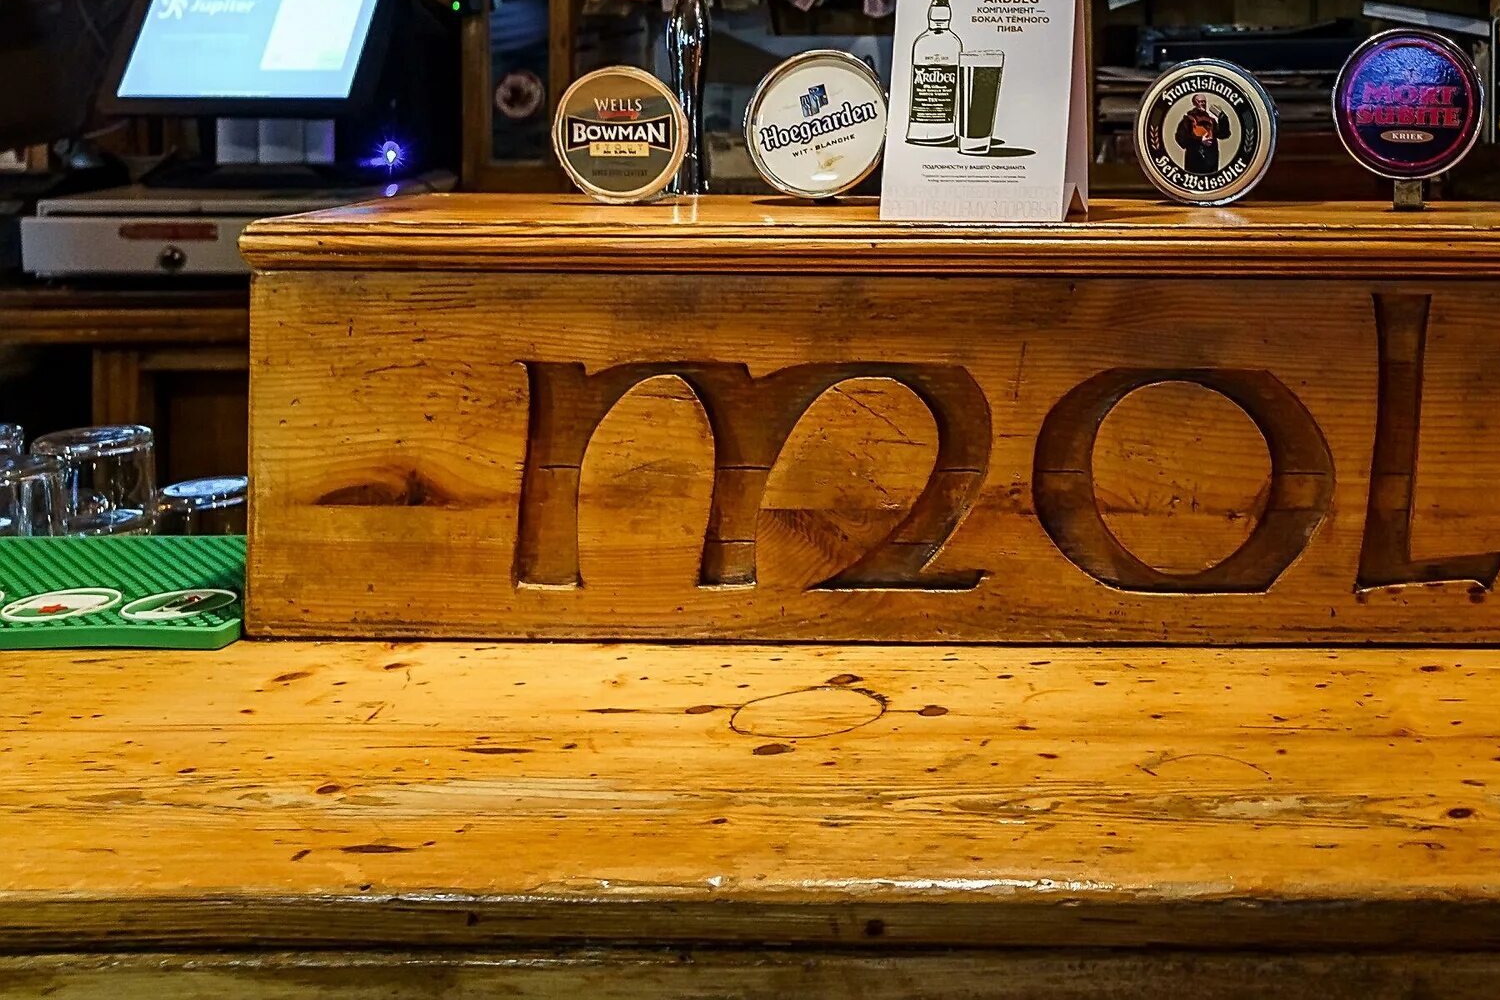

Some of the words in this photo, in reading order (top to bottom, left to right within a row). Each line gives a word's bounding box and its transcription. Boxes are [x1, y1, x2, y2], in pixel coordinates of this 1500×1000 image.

[977, 6, 1035, 14] КОМПЛИМЕНТ
[997, 25, 1024, 33] ПИВА
[1162, 77, 1244, 106] Franziskaner
[594, 97, 642, 112] WELLS
[760, 101, 878, 152] Hoegaarden
[1355, 106, 1464, 127] SUBITE
[573, 122, 666, 143] BOWMAN
[1391, 132, 1425, 142] KRIEK
[792, 149, 808, 158] WIT
[815, 133, 856, 151] BLANCHE
